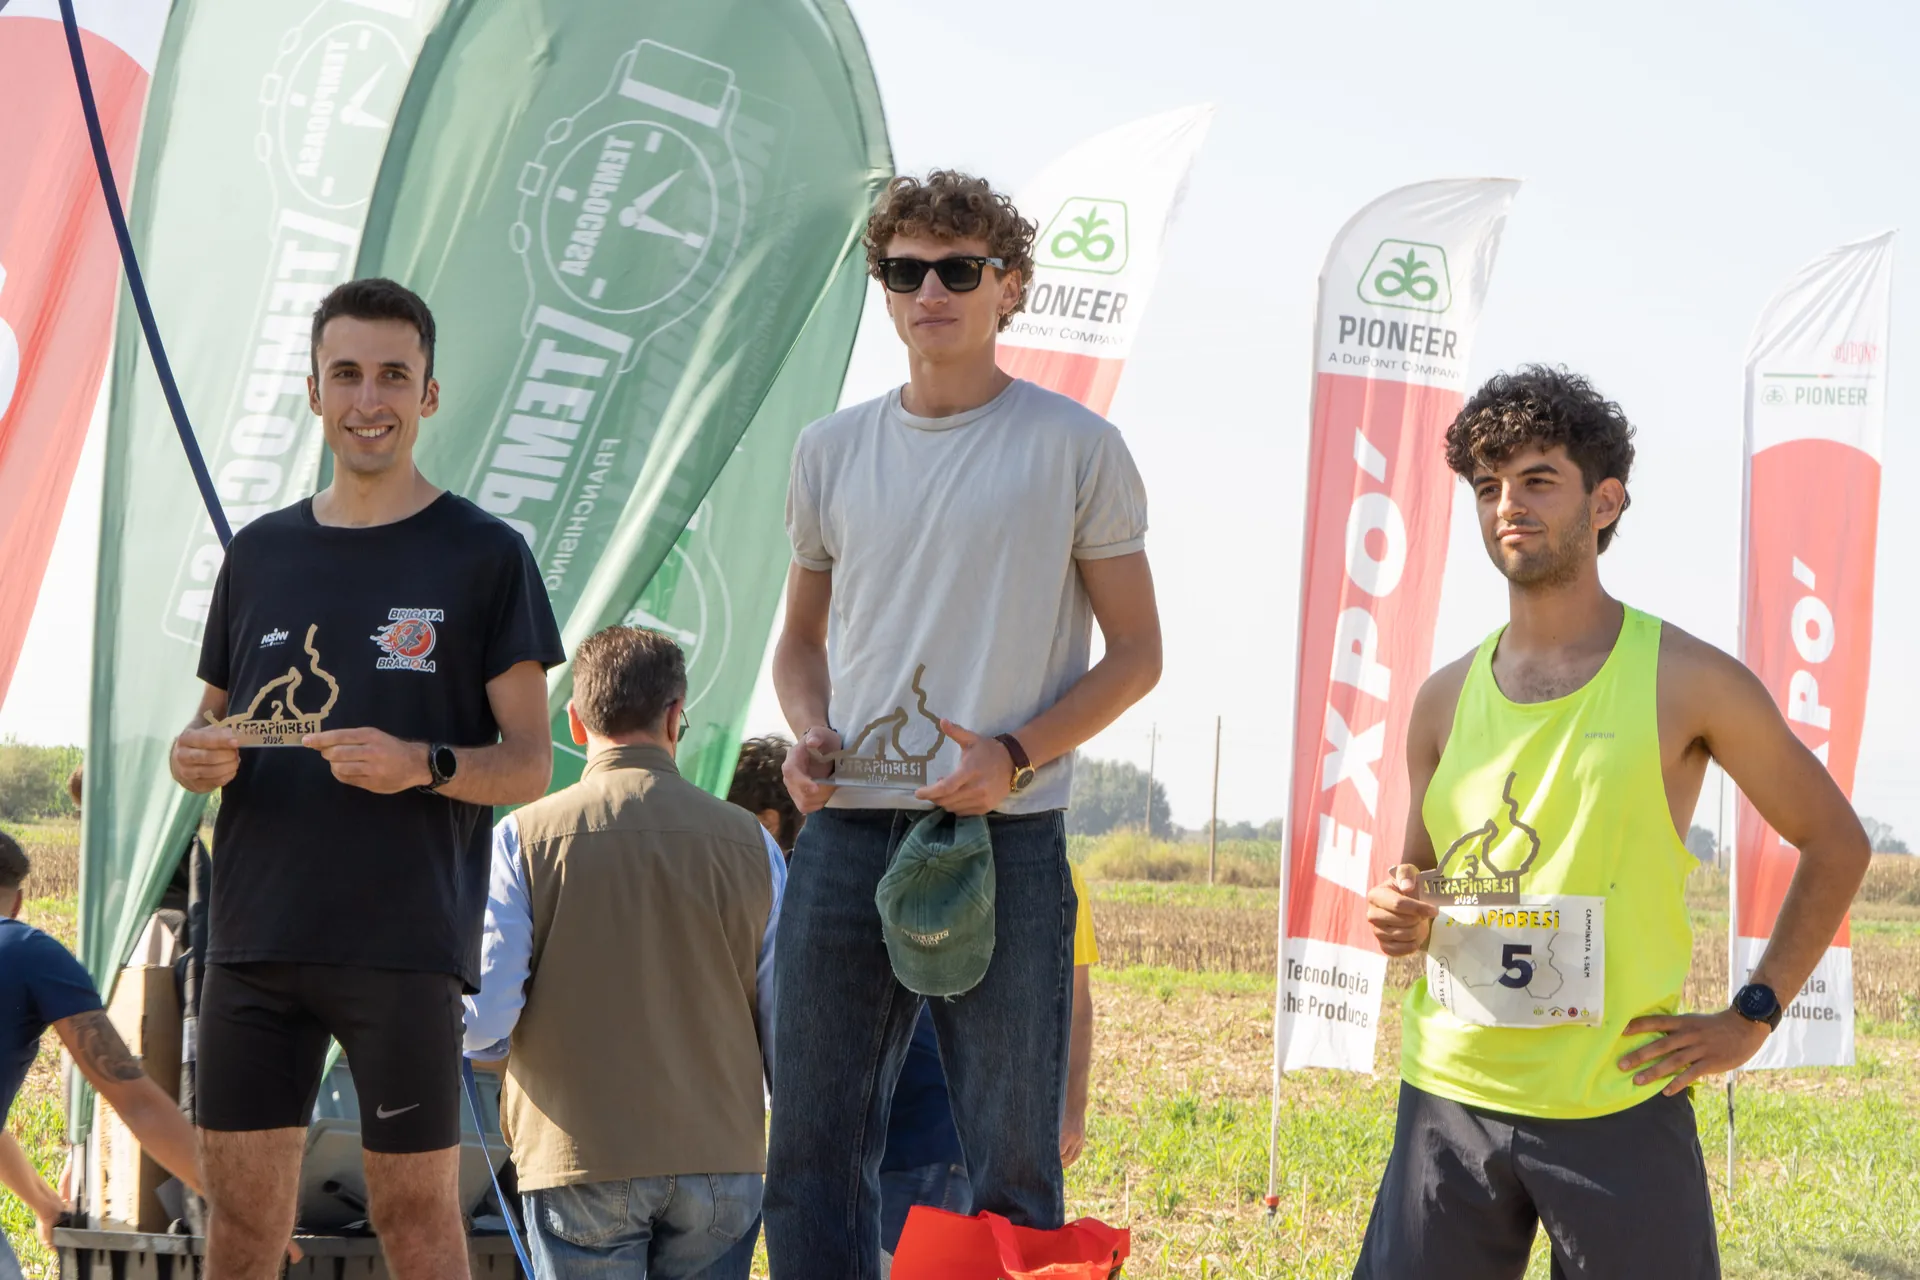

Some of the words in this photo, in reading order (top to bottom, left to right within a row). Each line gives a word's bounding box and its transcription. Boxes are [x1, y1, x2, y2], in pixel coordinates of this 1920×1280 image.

[1030, 283, 1129, 324] ONEER
[1010, 322, 1055, 337] UPONT
[1338, 315, 1458, 360] PIONEER
[1328, 352, 1338, 363] A
[1401, 360, 1461, 379] COMPANY
[1794, 385, 1868, 406] PIONEER
[388, 607, 444, 622] BRIGATA
[376, 657, 436, 673] BRACIOLA
[271, 700, 284, 720] 2
[1464, 854, 1479, 877] 3
[1454, 894, 1479, 906] 2026
[1287, 957, 1369, 995] Tecnologia
[1498, 943, 1533, 989] 5
[1283, 991, 1304, 1014] he
[1308, 995, 1369, 1029] Produce
[1783, 1001, 1834, 1021] oduce
